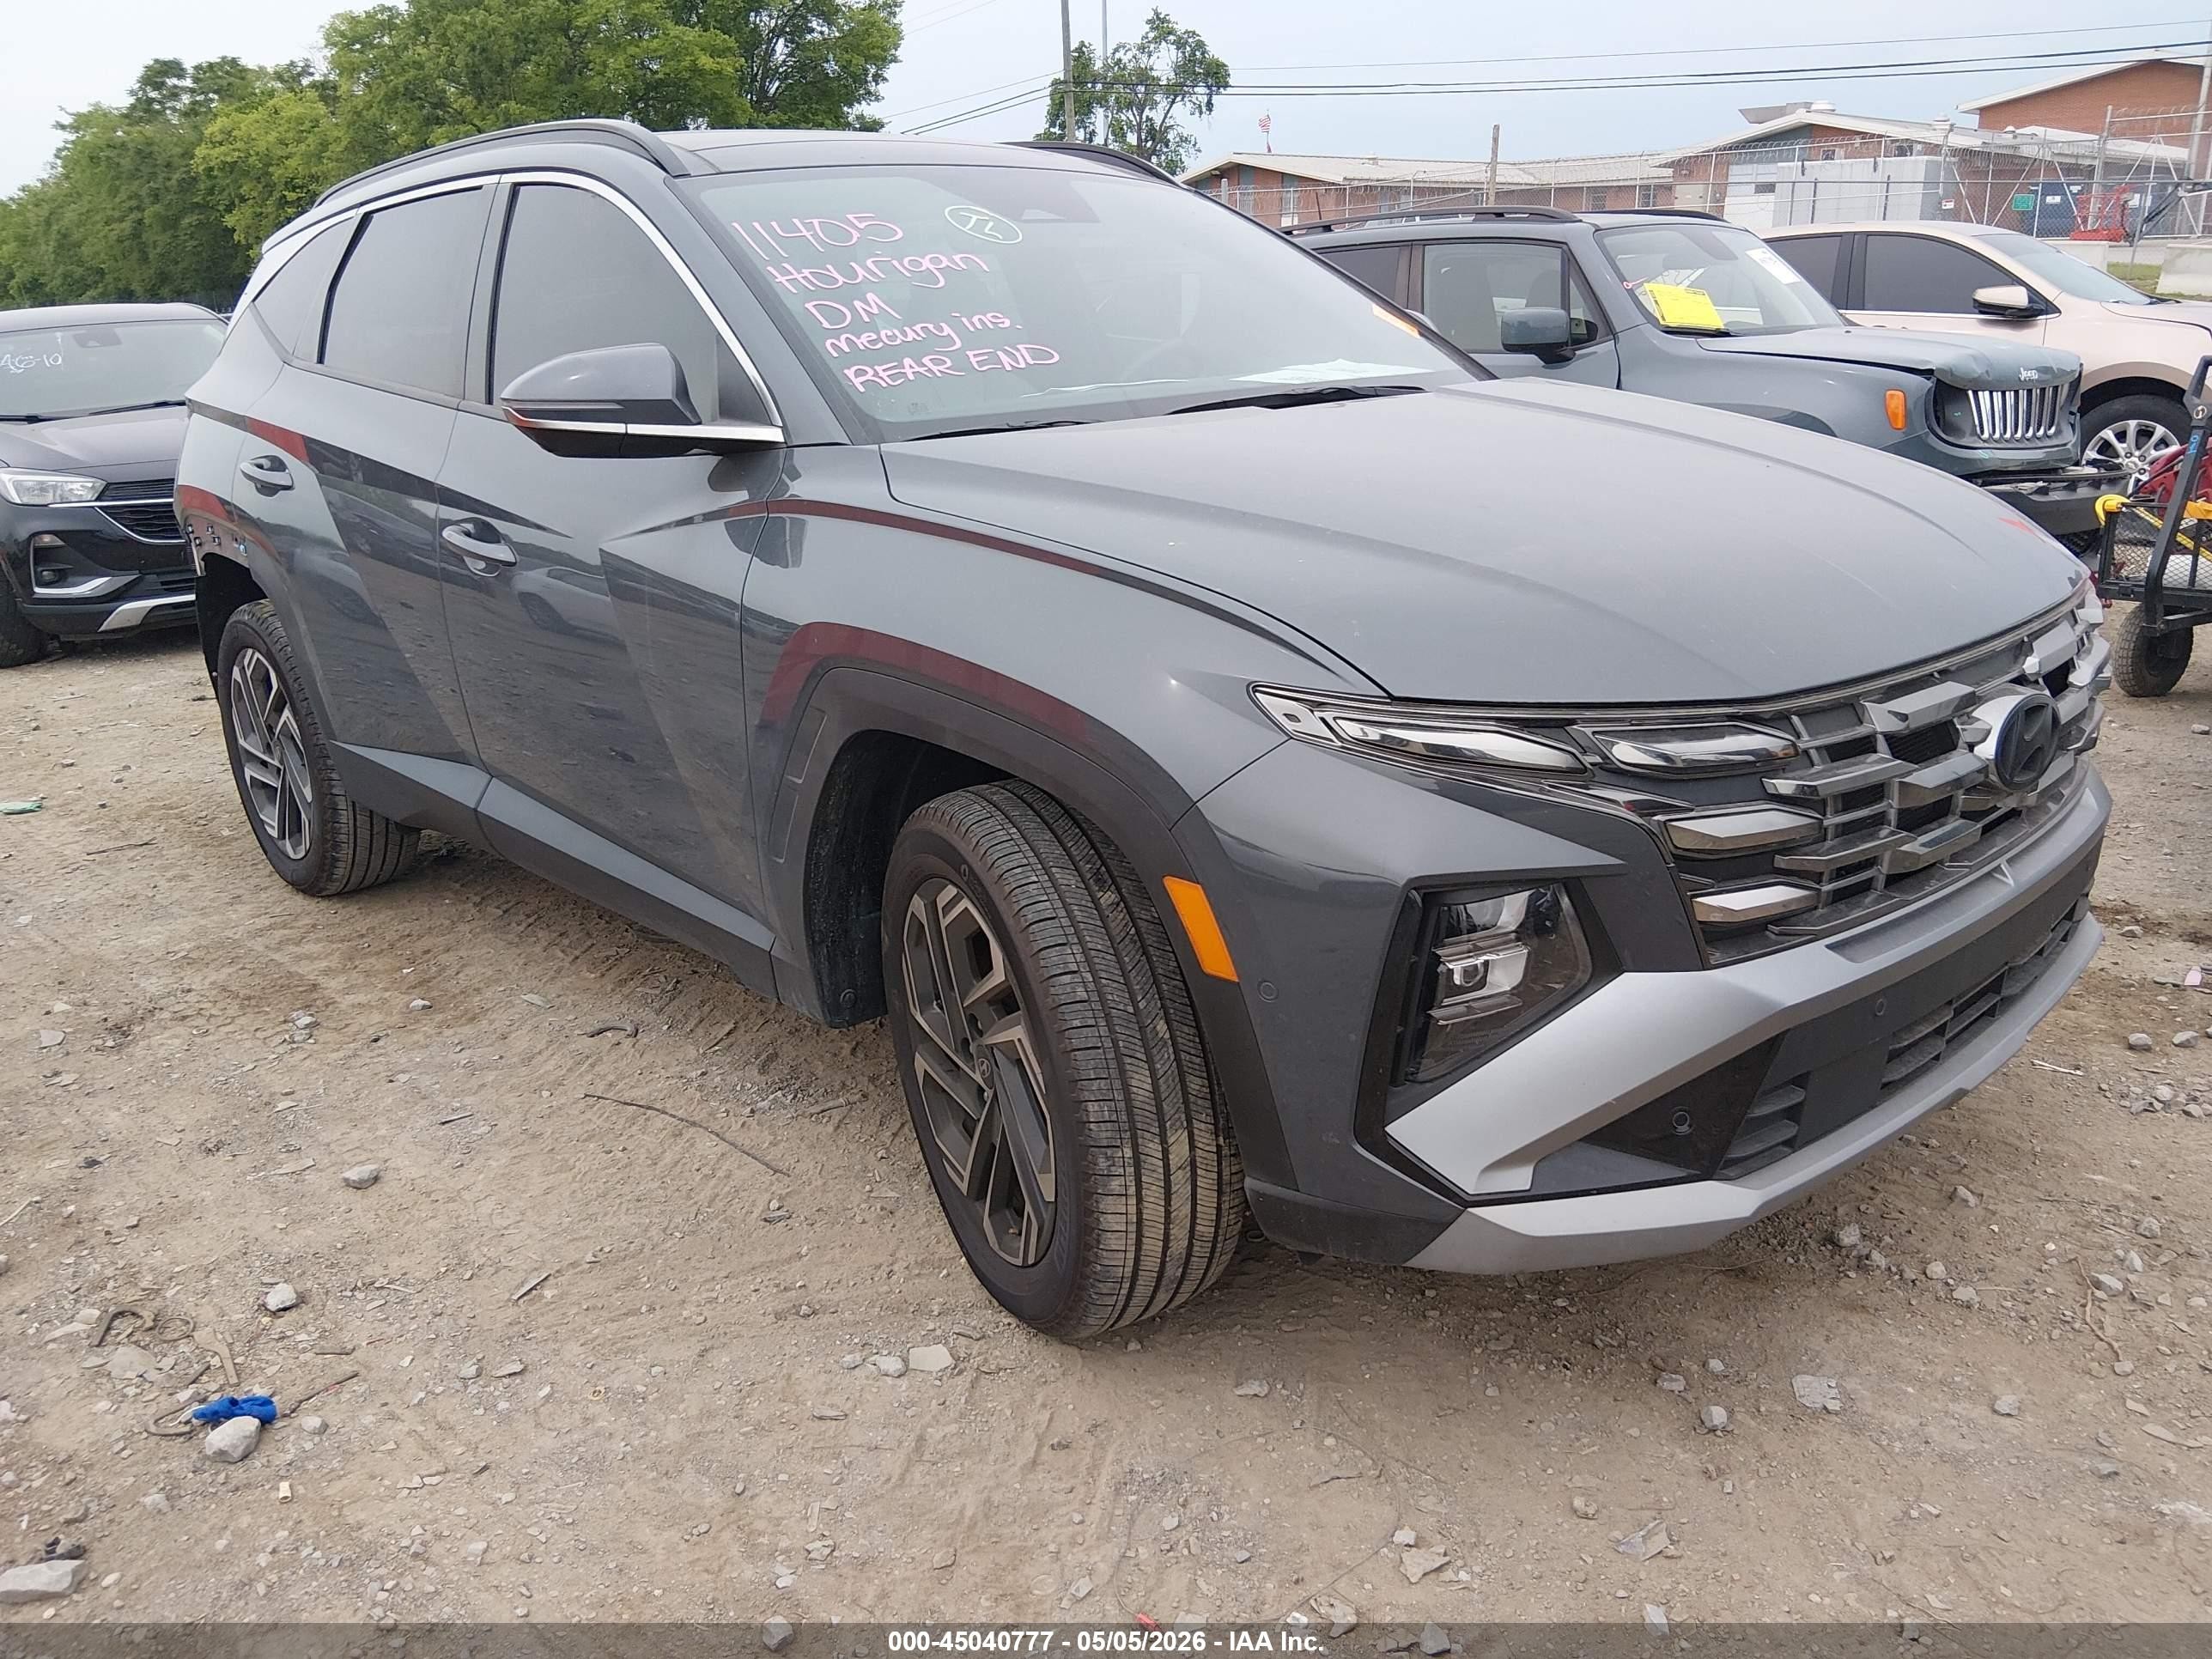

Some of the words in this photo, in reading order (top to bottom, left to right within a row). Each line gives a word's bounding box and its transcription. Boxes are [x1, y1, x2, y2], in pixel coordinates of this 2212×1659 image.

[732, 213, 904, 261] 11405
[766, 250, 990, 294] Hourigan
[804, 291, 902, 330] DM
[950, 311, 1024, 332] ins.
[842, 354, 966, 393] REAR
[965, 343, 1060, 372] END
[2019, 367, 2039, 383] Jeep
